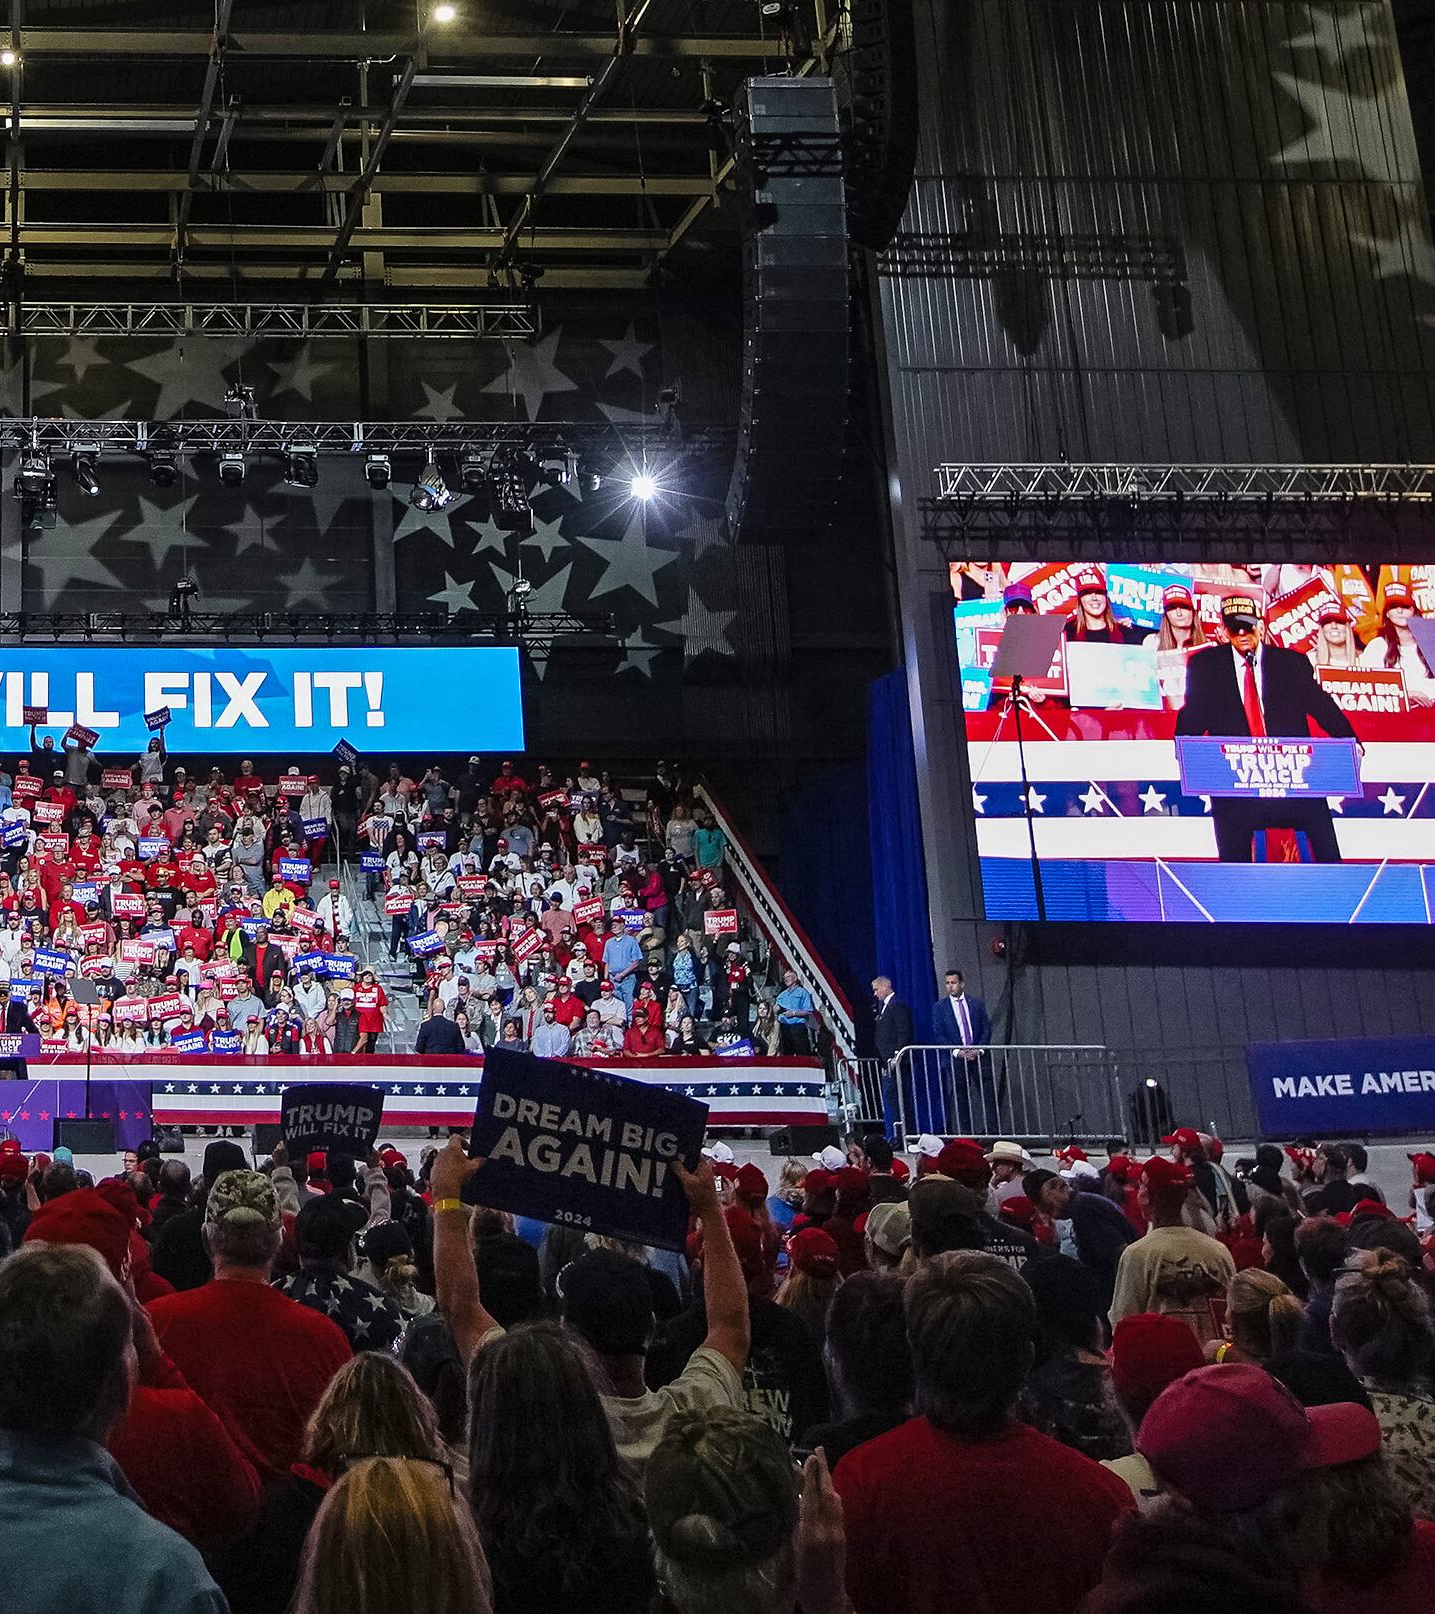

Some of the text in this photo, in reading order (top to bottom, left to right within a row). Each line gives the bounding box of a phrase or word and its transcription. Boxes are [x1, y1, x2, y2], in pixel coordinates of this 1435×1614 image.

[1322, 681, 1373, 695] DREAM
[145, 672, 269, 727] FIX
[294, 672, 385, 727] IT!
[1256, 745, 1281, 754] WILL
[1225, 753, 1311, 770] TRUMP
[1235, 769, 1304, 783] VANCE
[324, 959, 352, 969] TRUMP
[150, 999, 179, 1010] TRUMP
[1272, 1074, 1354, 1098] MAKE
[285, 1103, 374, 1126] TRUMP
[492, 1092, 612, 1142] DREAM
[285, 1122, 371, 1141] WILL FIX IT
[488, 1126, 667, 1198] AGAIN!
[554, 1209, 592, 1227] 2024
